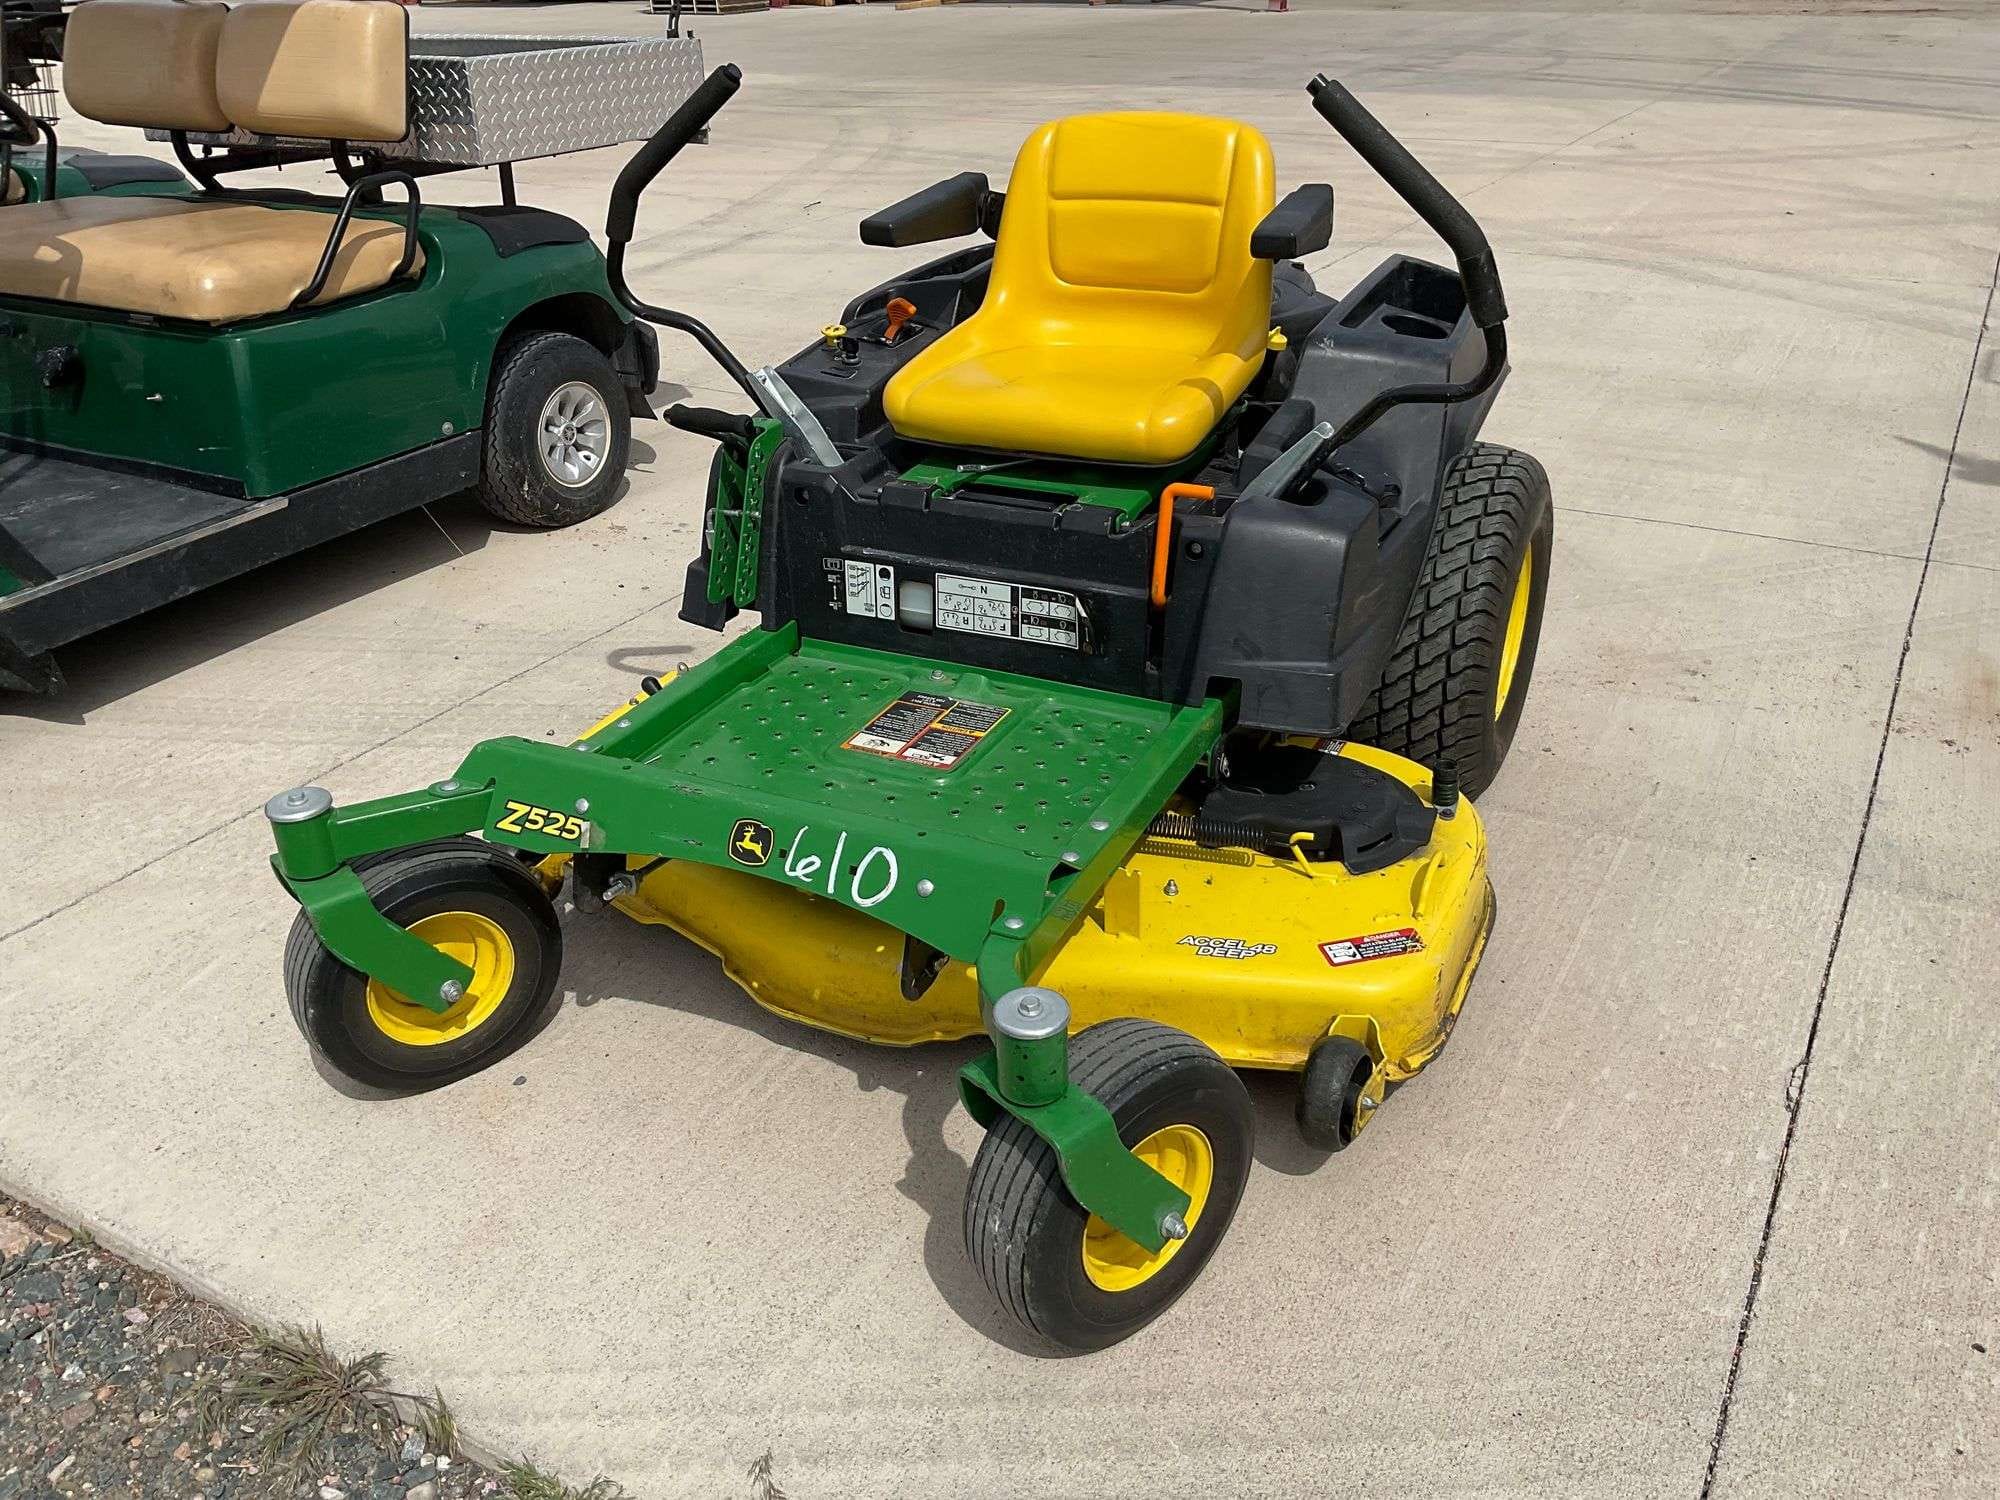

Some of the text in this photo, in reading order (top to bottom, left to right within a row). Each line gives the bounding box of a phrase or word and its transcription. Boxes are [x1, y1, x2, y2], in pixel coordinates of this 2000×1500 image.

[495, 800, 583, 840] Z525
[785, 825, 898, 907] 610
[1177, 935, 1278, 955] ACCEL 48
[1196, 946, 1257, 960] DEEP
